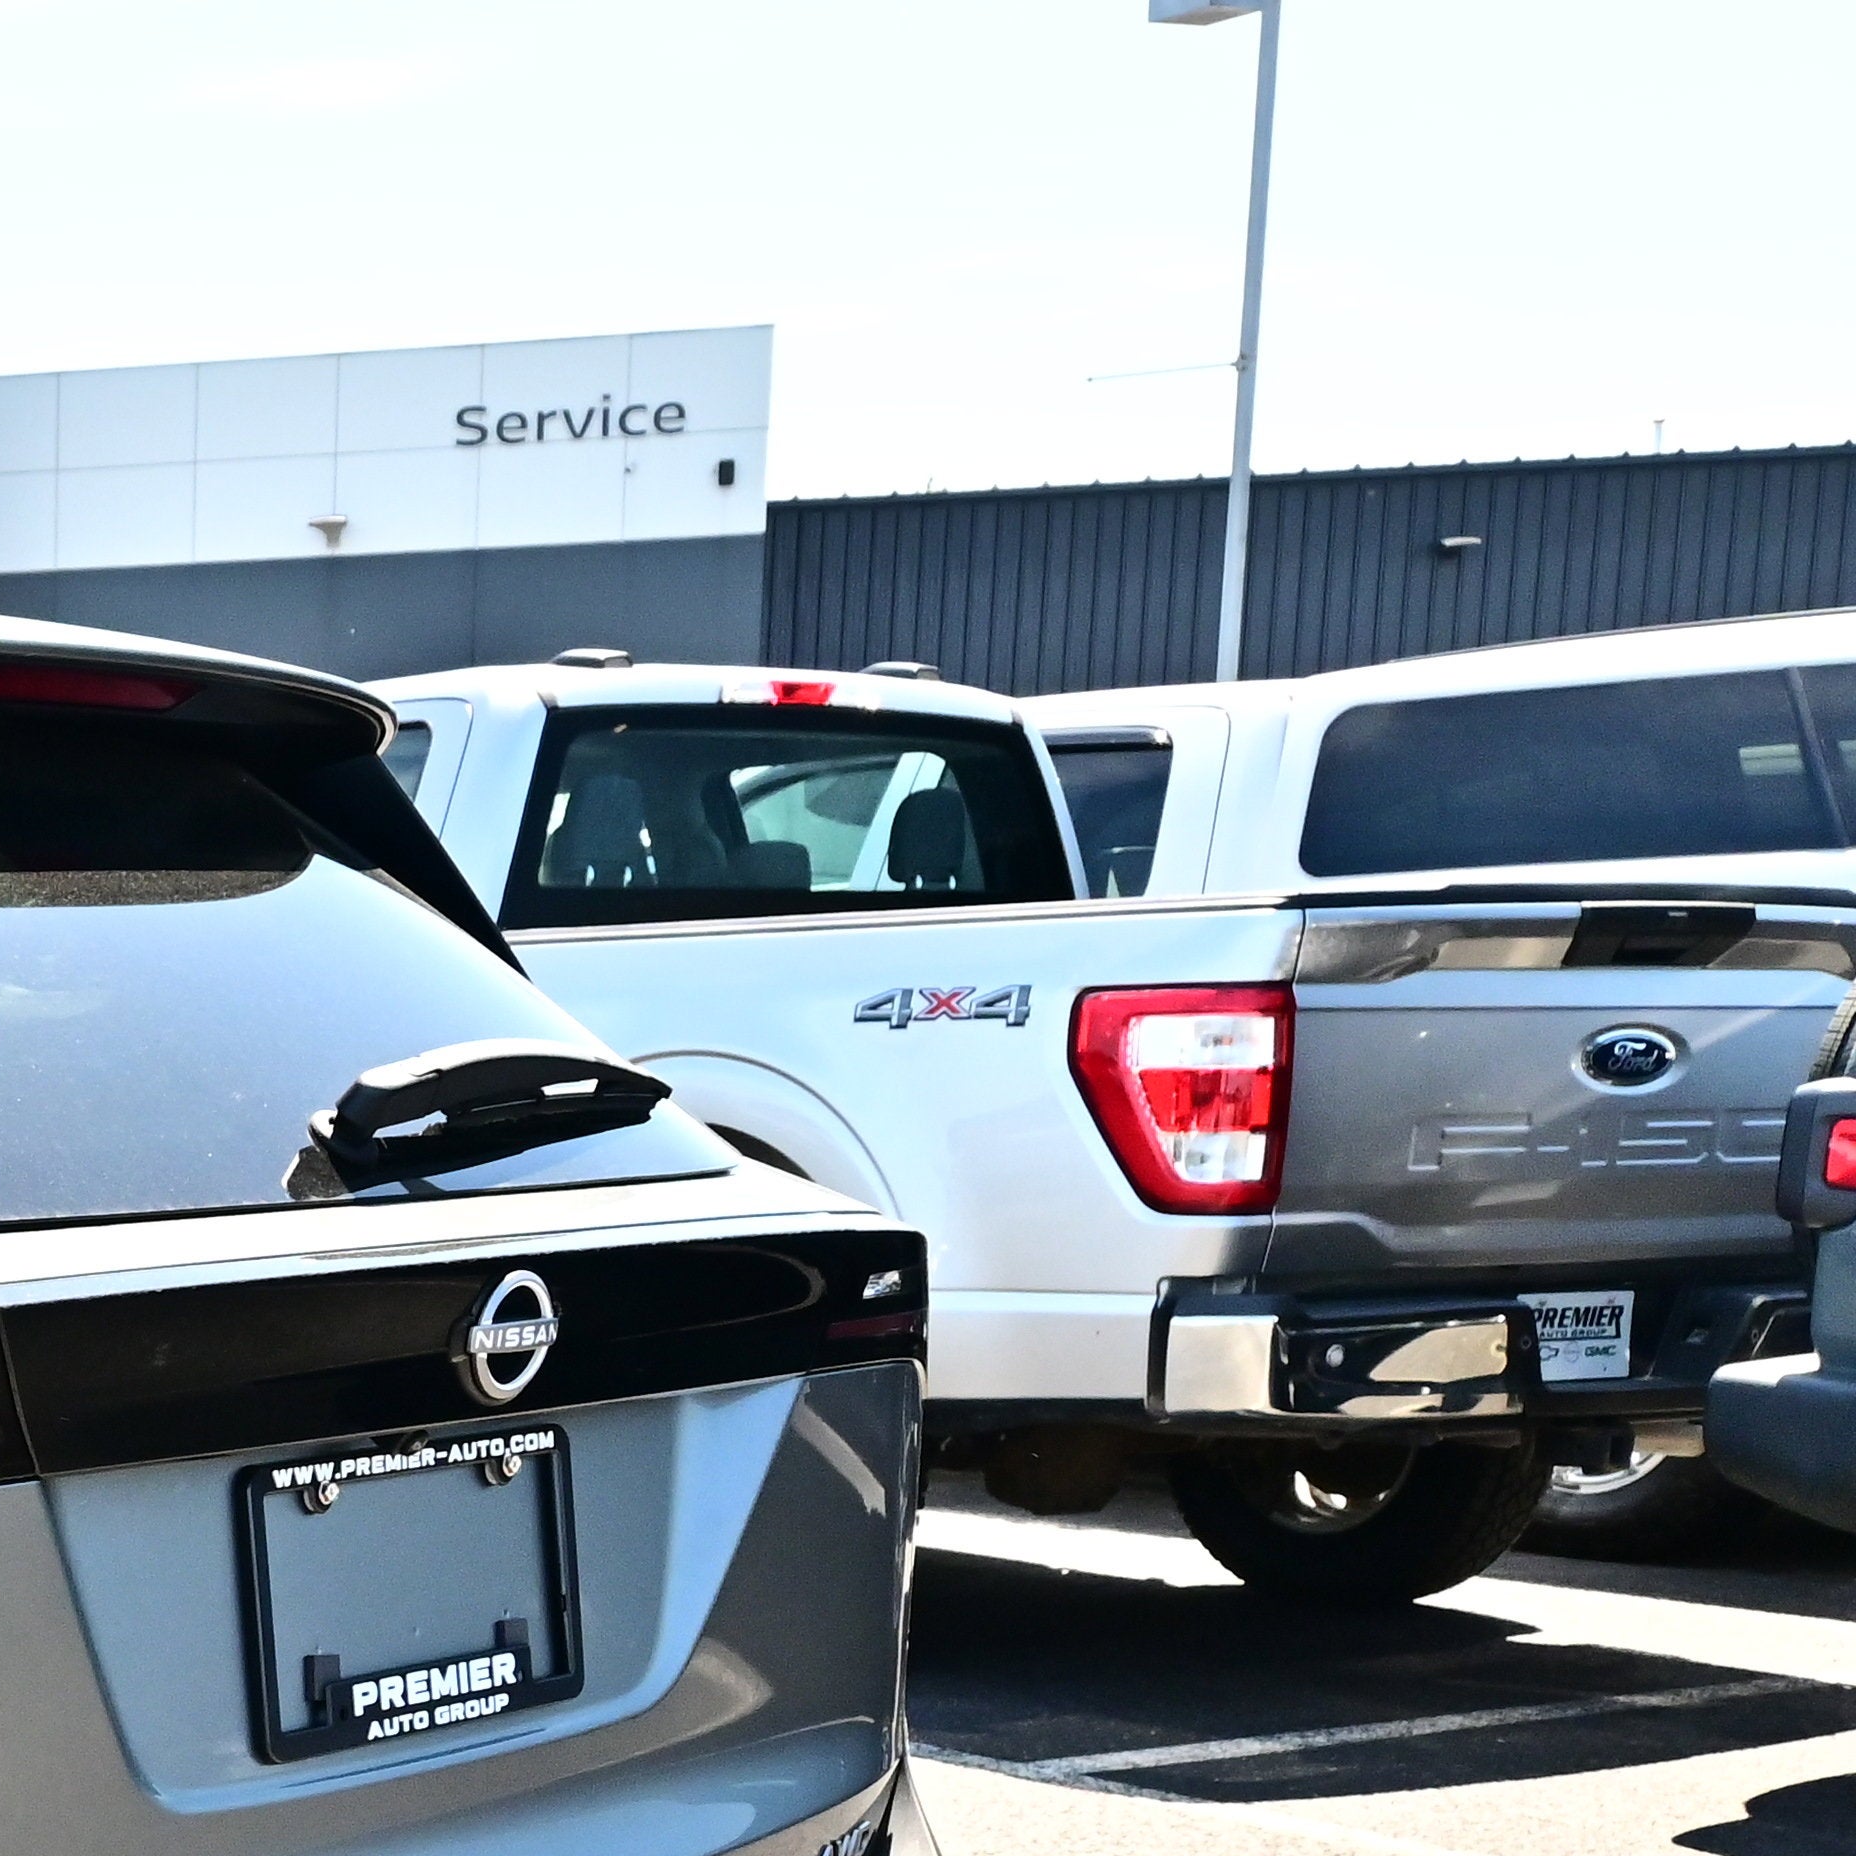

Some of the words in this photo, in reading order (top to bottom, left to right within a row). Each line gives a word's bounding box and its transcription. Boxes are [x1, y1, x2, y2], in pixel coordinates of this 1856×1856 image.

[455, 394, 687, 447] Service
[1607, 1040, 1659, 1074] Ford
[474, 1322, 557, 1349] NISSAN
[1584, 1345, 1616, 1357] GMC
[352, 1652, 517, 1717] PREMIER
[367, 1710, 430, 1741] AUTO
[433, 1693, 510, 1725] GROUP
